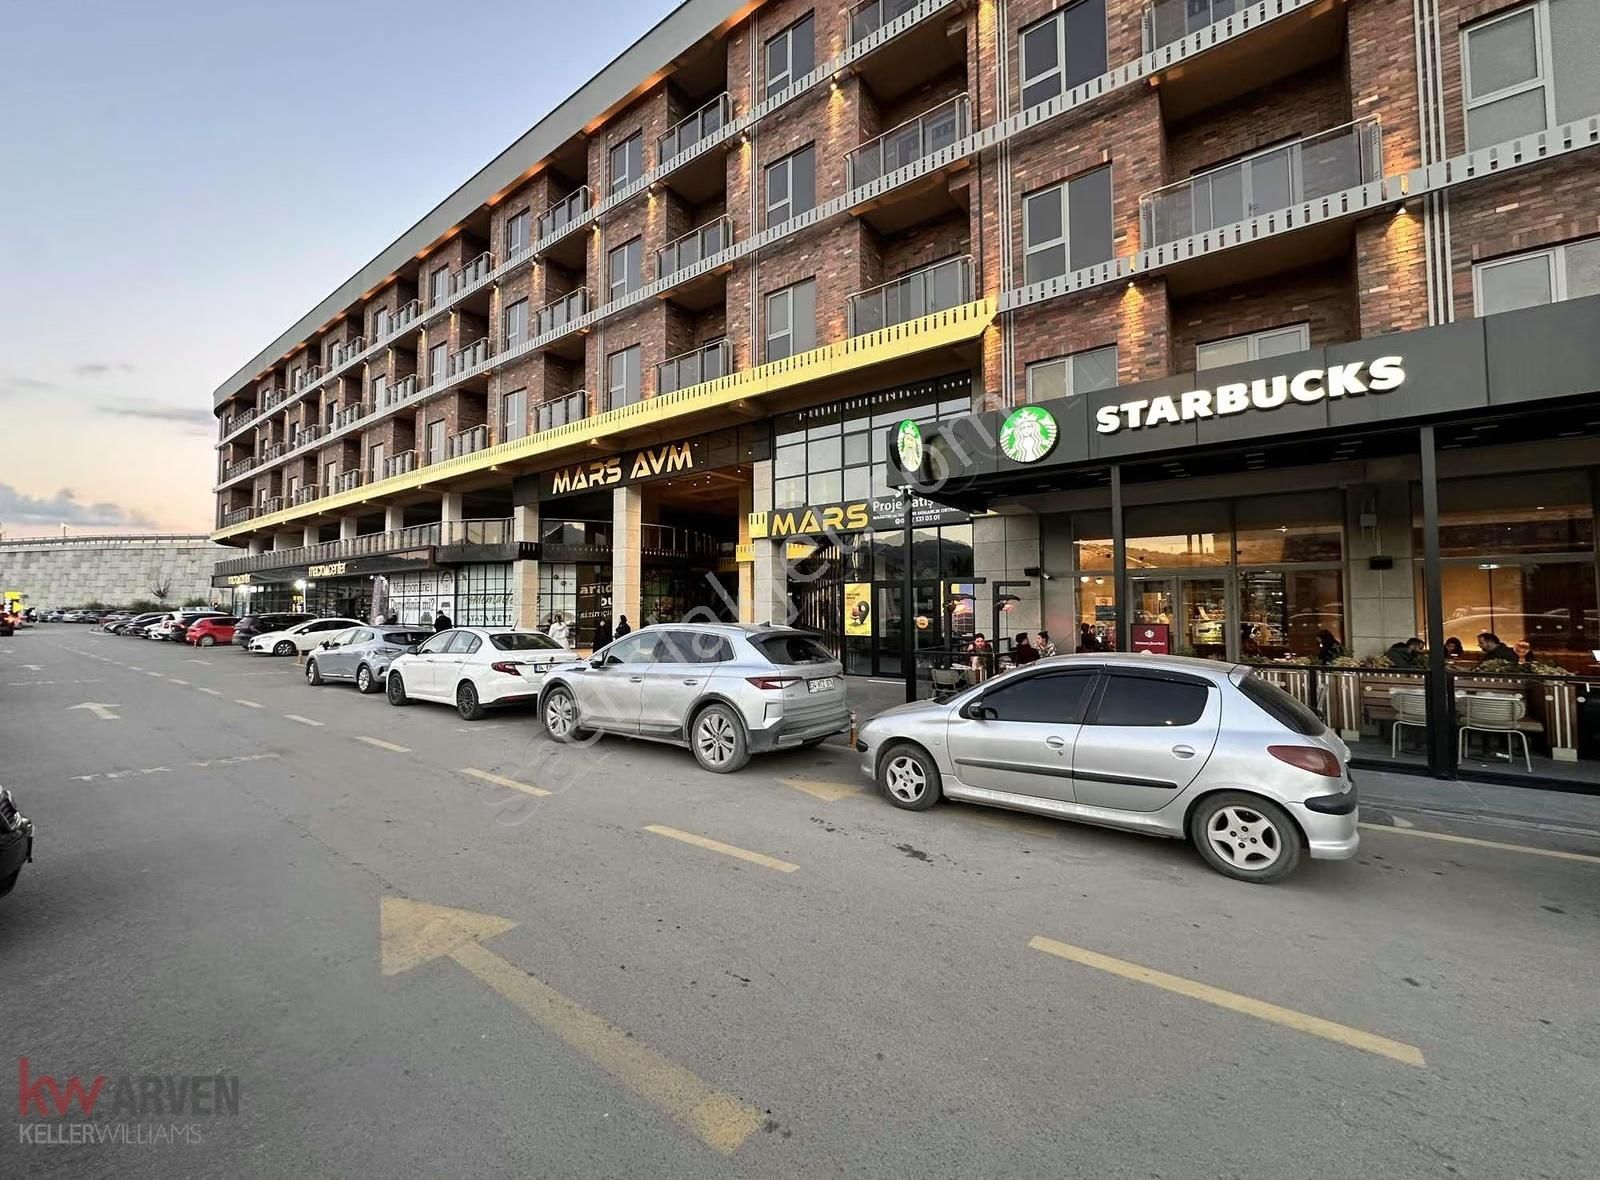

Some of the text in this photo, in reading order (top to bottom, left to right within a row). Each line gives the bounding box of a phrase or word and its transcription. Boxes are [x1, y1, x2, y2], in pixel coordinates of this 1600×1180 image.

[1095, 355, 1406, 434] STARBUCKS
[552, 441, 693, 495] MARS AVM
[770, 503, 869, 536] MARS
[872, 498, 934, 513] Proje atış
